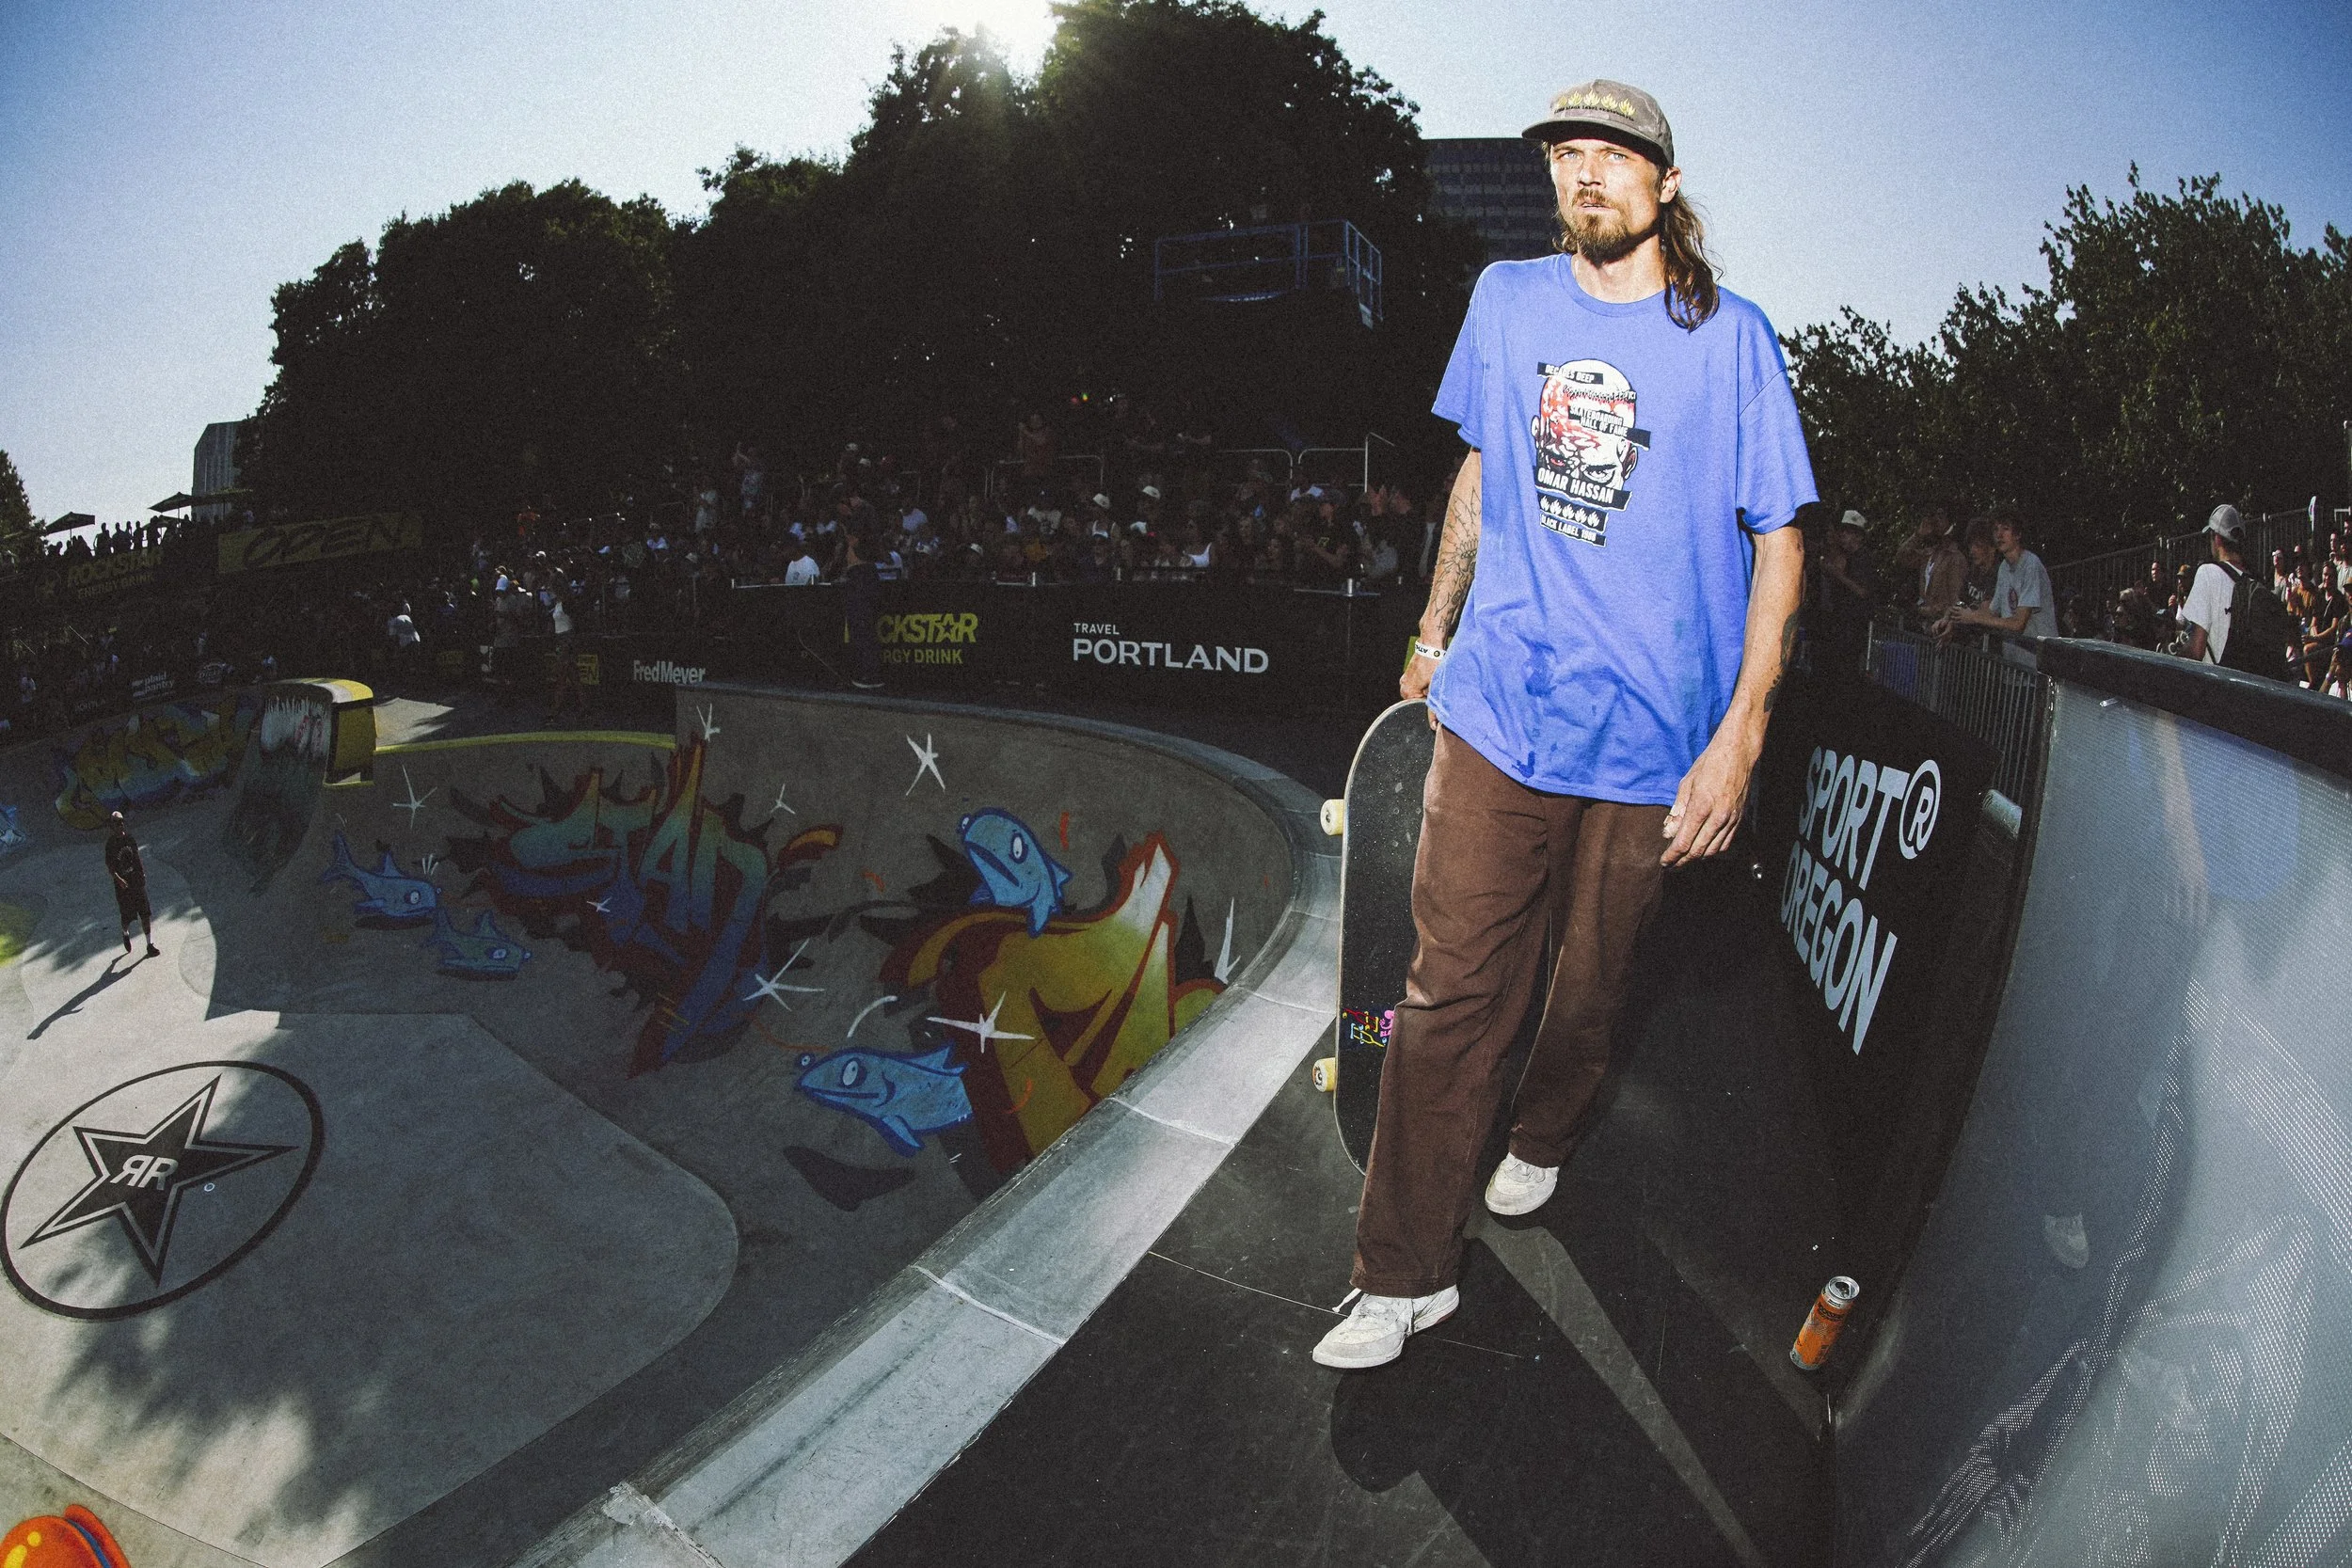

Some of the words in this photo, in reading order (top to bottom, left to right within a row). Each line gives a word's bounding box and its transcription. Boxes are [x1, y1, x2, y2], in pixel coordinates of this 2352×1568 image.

[1545, 364, 1576, 380] DECADES
[1575, 372, 1595, 383] DEEP
[1569, 404, 1624, 427] SKATEBOARDING
[1581, 416, 1598, 430] HALL
[1598, 420, 1609, 434] OF
[1609, 422, 1629, 437] FAME
[1537, 467, 1569, 491] OMAR
[1569, 478, 1615, 504] HASSAN
[1557, 519, 1580, 537] LABEL
[845, 613, 978, 643] CKSTAR
[1073, 623, 1120, 635] TRAVEL
[914, 649, 963, 664] DRINK
[1073, 638, 1269, 673] PORTLAND
[144, 672, 167, 686] plaid
[145, 680, 174, 694] pantry
[1781, 840, 1898, 1055] OREGON
